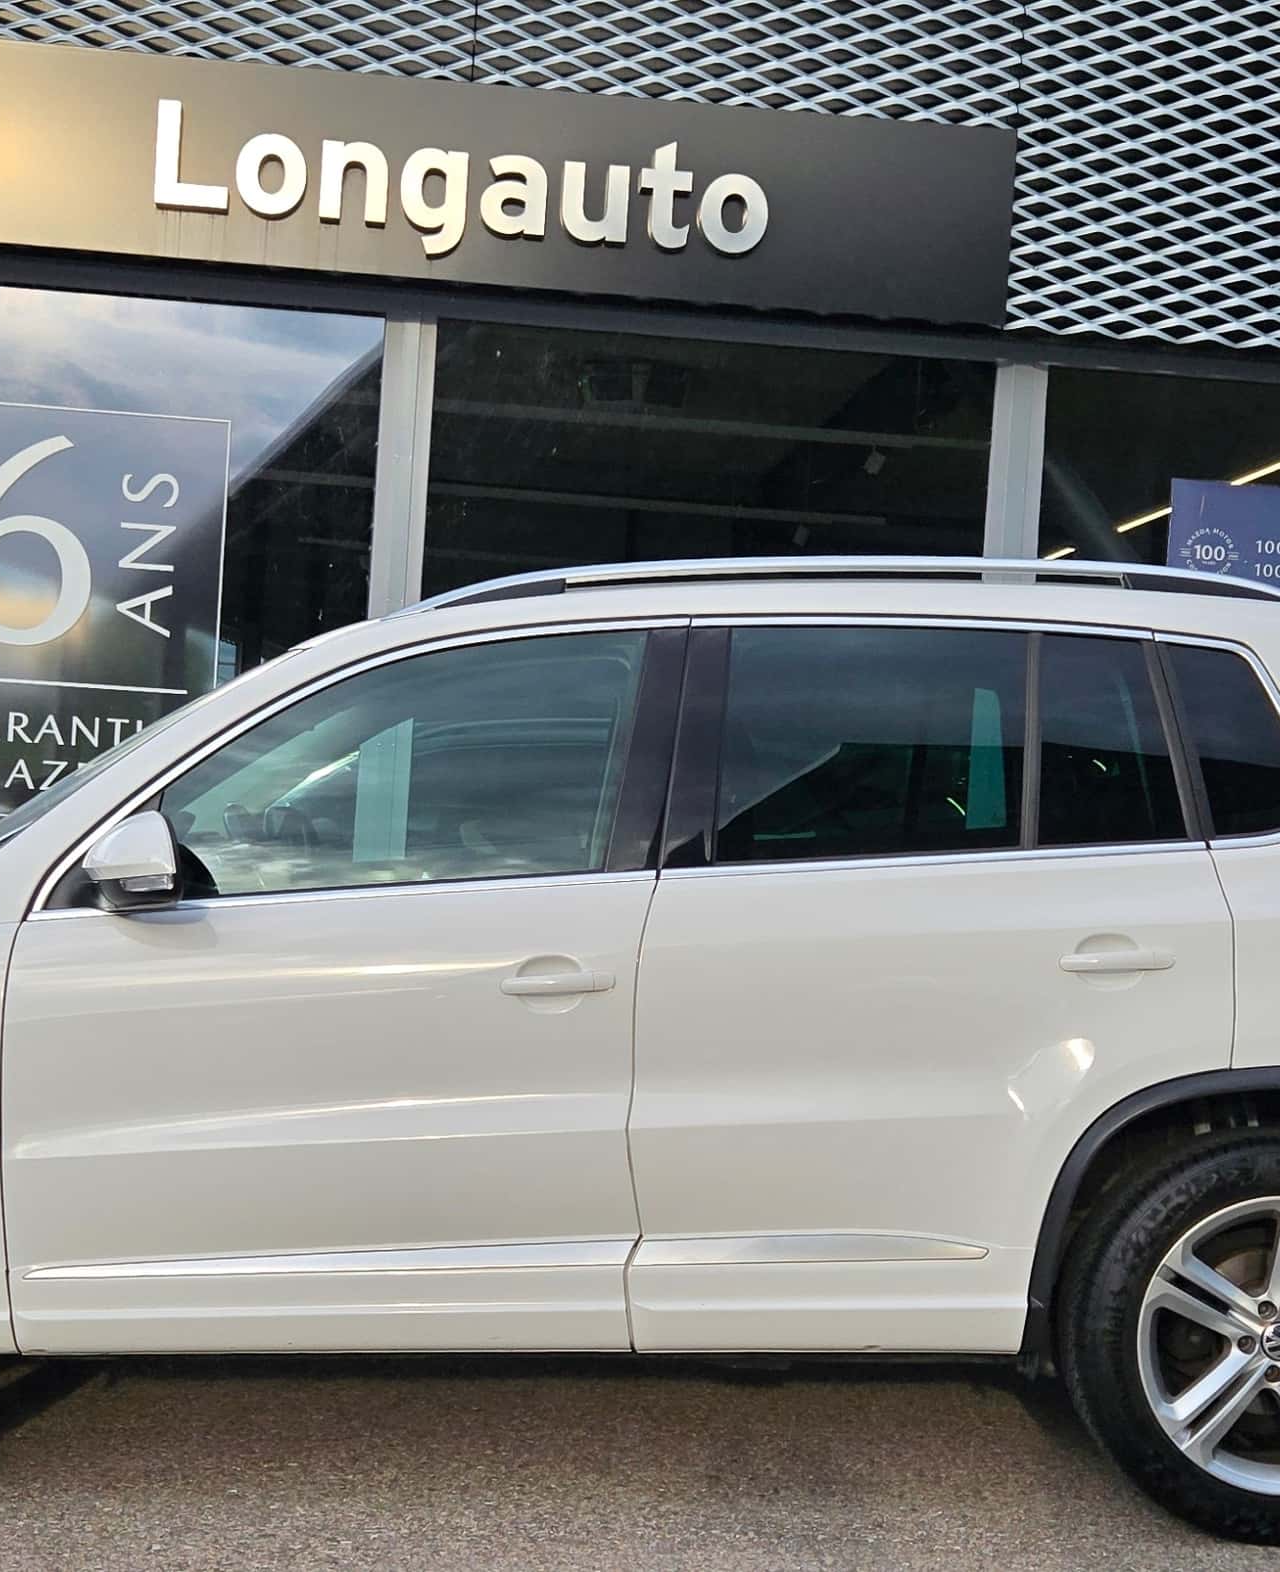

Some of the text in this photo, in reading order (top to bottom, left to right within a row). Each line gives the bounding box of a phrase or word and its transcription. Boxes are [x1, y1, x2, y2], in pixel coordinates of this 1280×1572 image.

[153, 98, 770, 257] Longauto
[115, 472, 179, 639] ANS
[1186, 527, 1235, 550] MAZDA MOTOR
[1194, 544, 1226, 561] 100
